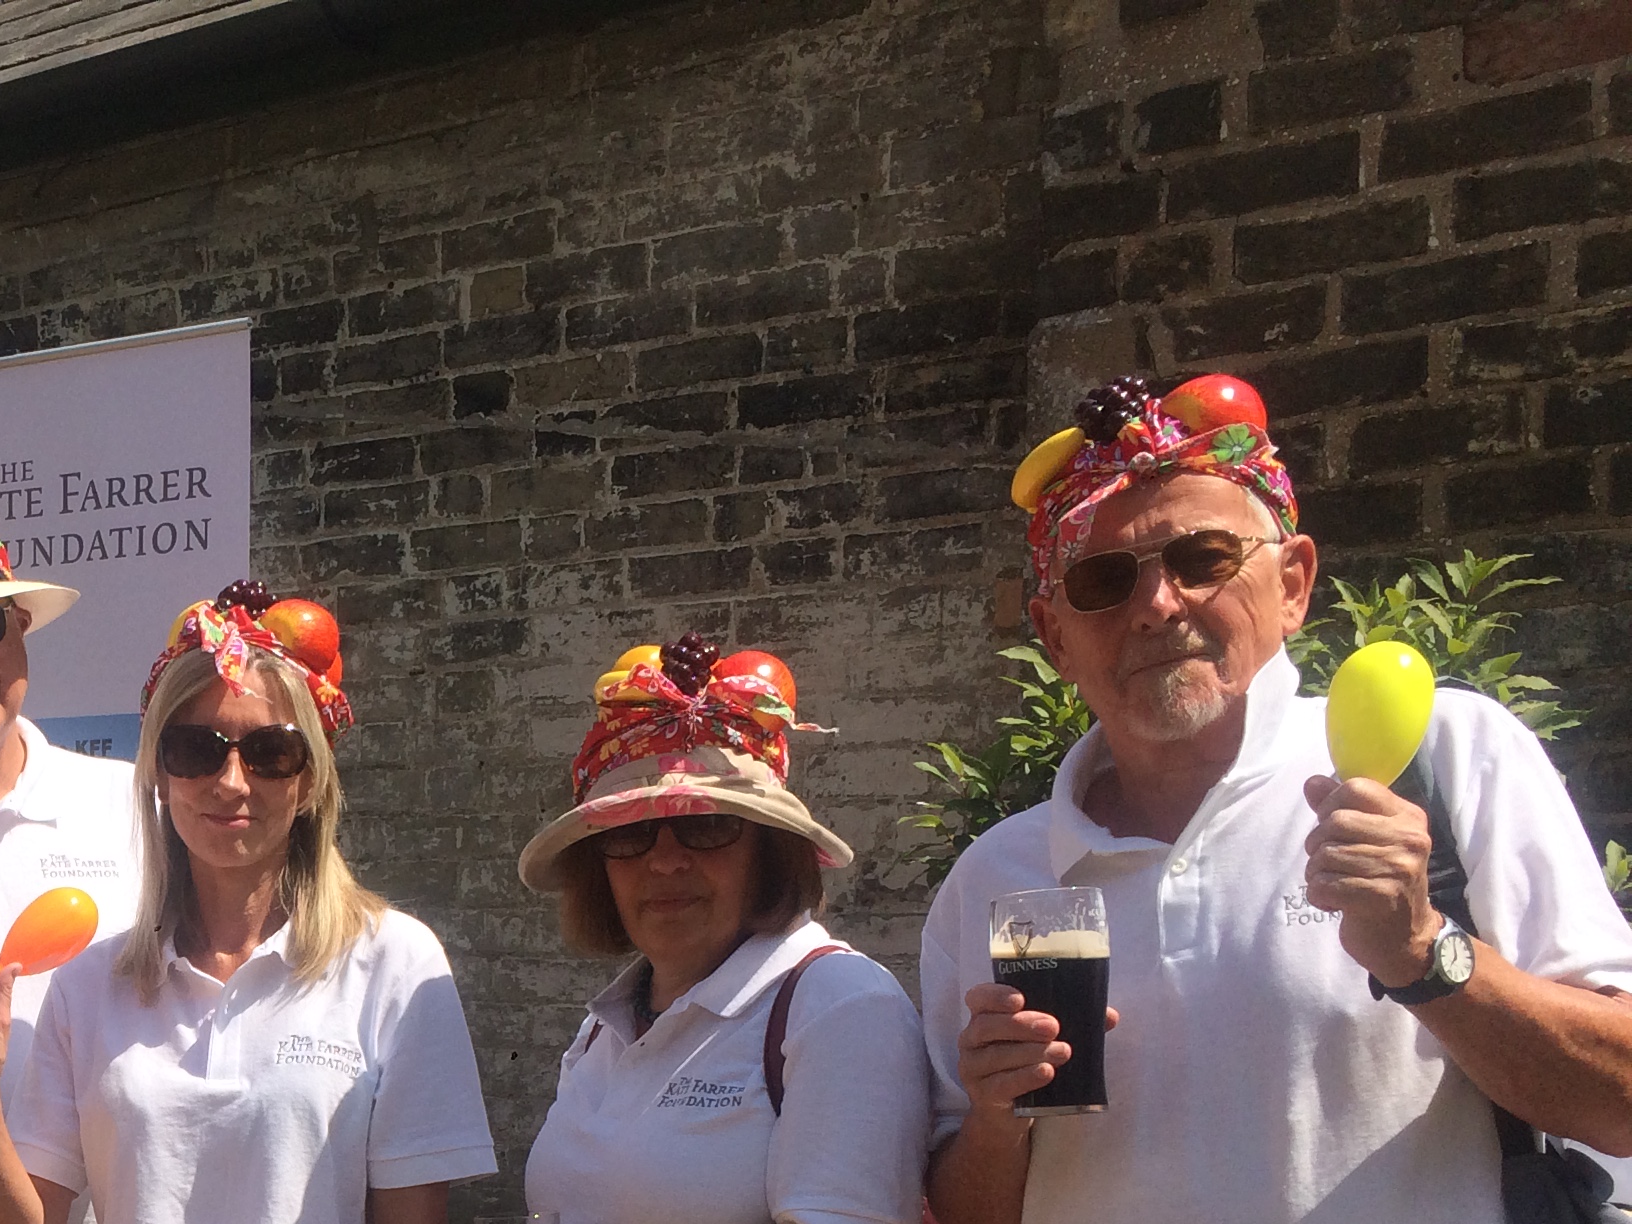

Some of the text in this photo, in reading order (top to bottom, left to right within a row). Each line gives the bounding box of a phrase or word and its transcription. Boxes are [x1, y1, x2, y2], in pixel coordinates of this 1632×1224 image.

[58, 466, 212, 515] FARRER
[5, 518, 212, 570] UNDATION
[75, 738, 113, 757] KFF
[39, 858, 72, 868] KATE
[41, 868, 120, 879] FOUNDATION
[998, 957, 1058, 975] GUINNESS
[276, 1053, 361, 1077] FOUNDATION
